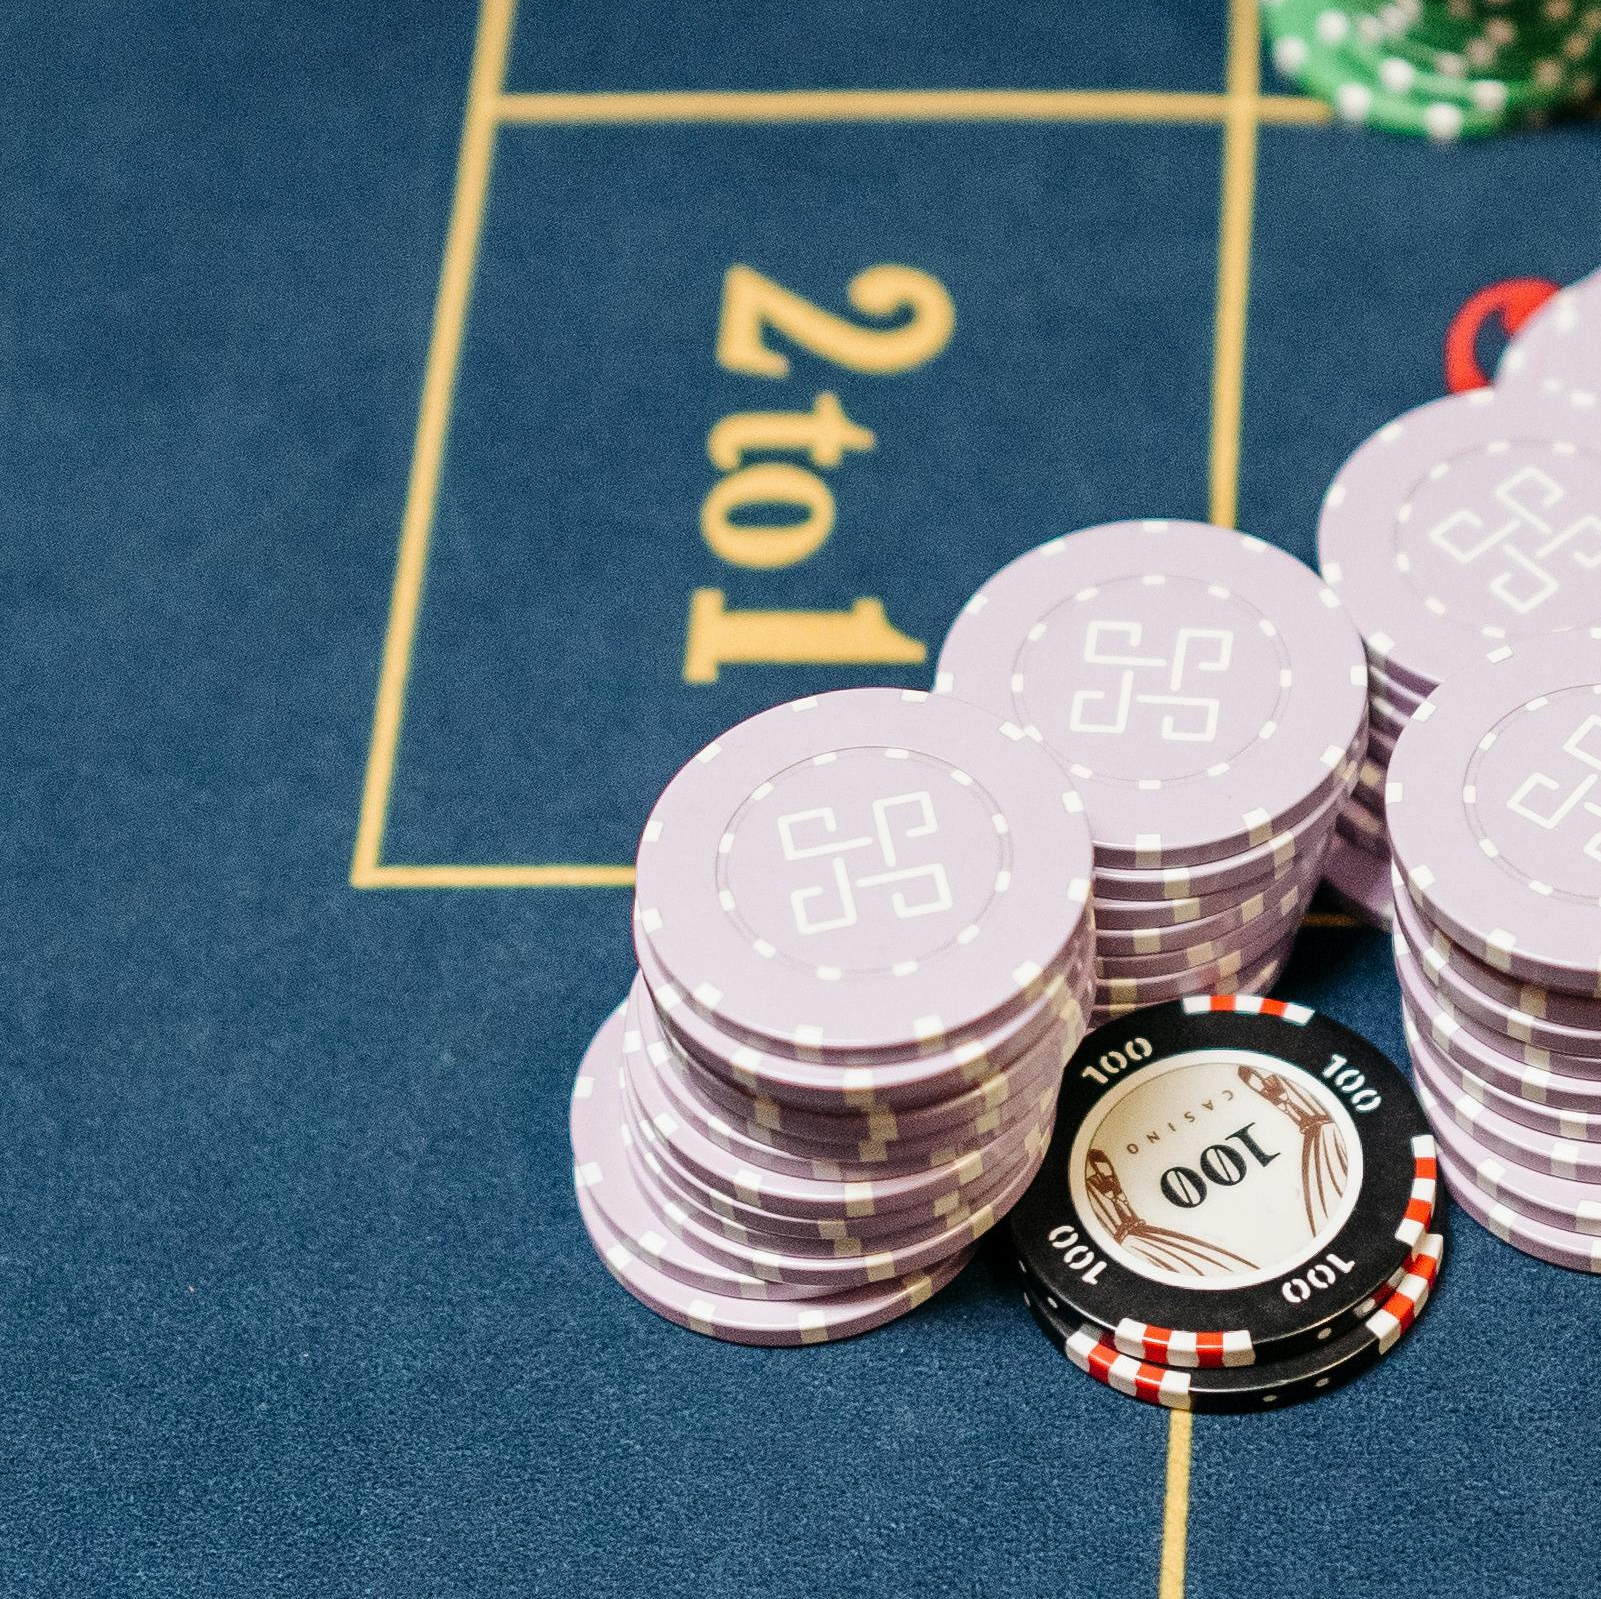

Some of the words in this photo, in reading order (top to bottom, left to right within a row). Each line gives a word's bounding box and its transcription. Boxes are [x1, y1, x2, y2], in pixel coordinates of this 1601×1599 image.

[1081, 1037, 1153, 1085] 100
[1322, 1053, 1382, 1113] 100
[1126, 1089, 1234, 1156] CASINO
[1160, 1121, 1281, 1209] 100
[1048, 1225, 1108, 1286] 100
[1281, 1253, 1356, 1303] 100
